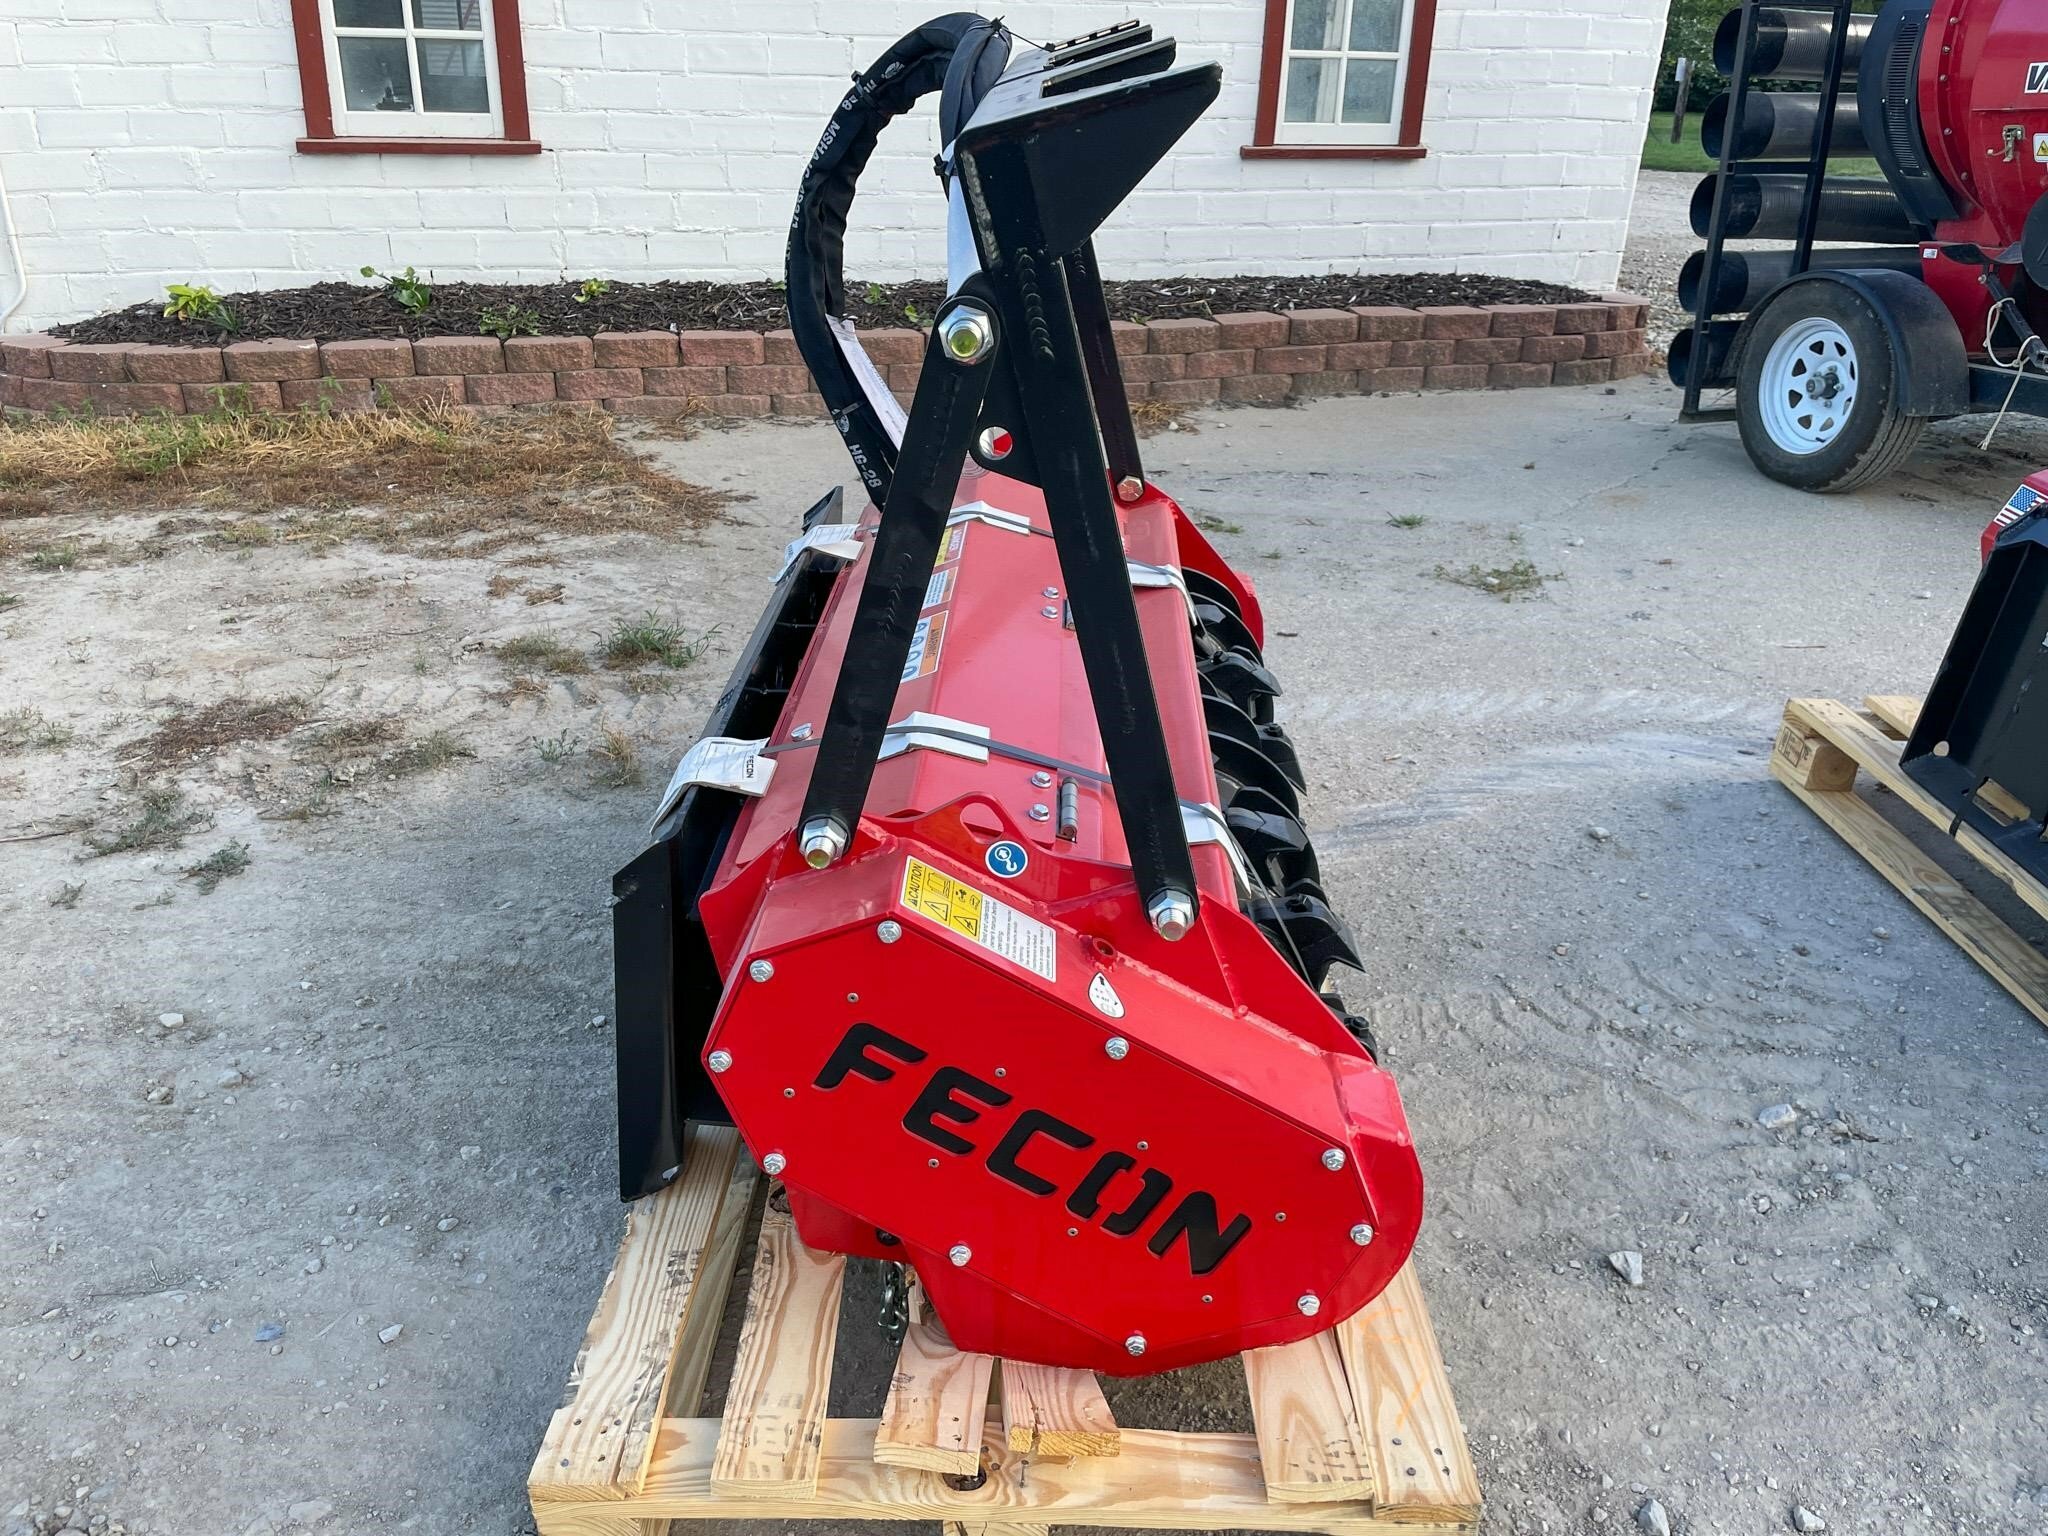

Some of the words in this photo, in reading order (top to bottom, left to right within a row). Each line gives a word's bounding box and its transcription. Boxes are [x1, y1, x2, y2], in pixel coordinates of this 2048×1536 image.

[849, 444, 882, 488] HG-28
[909, 863, 922, 895] CAUTION
[811, 1022, 1252, 1277] FECON
